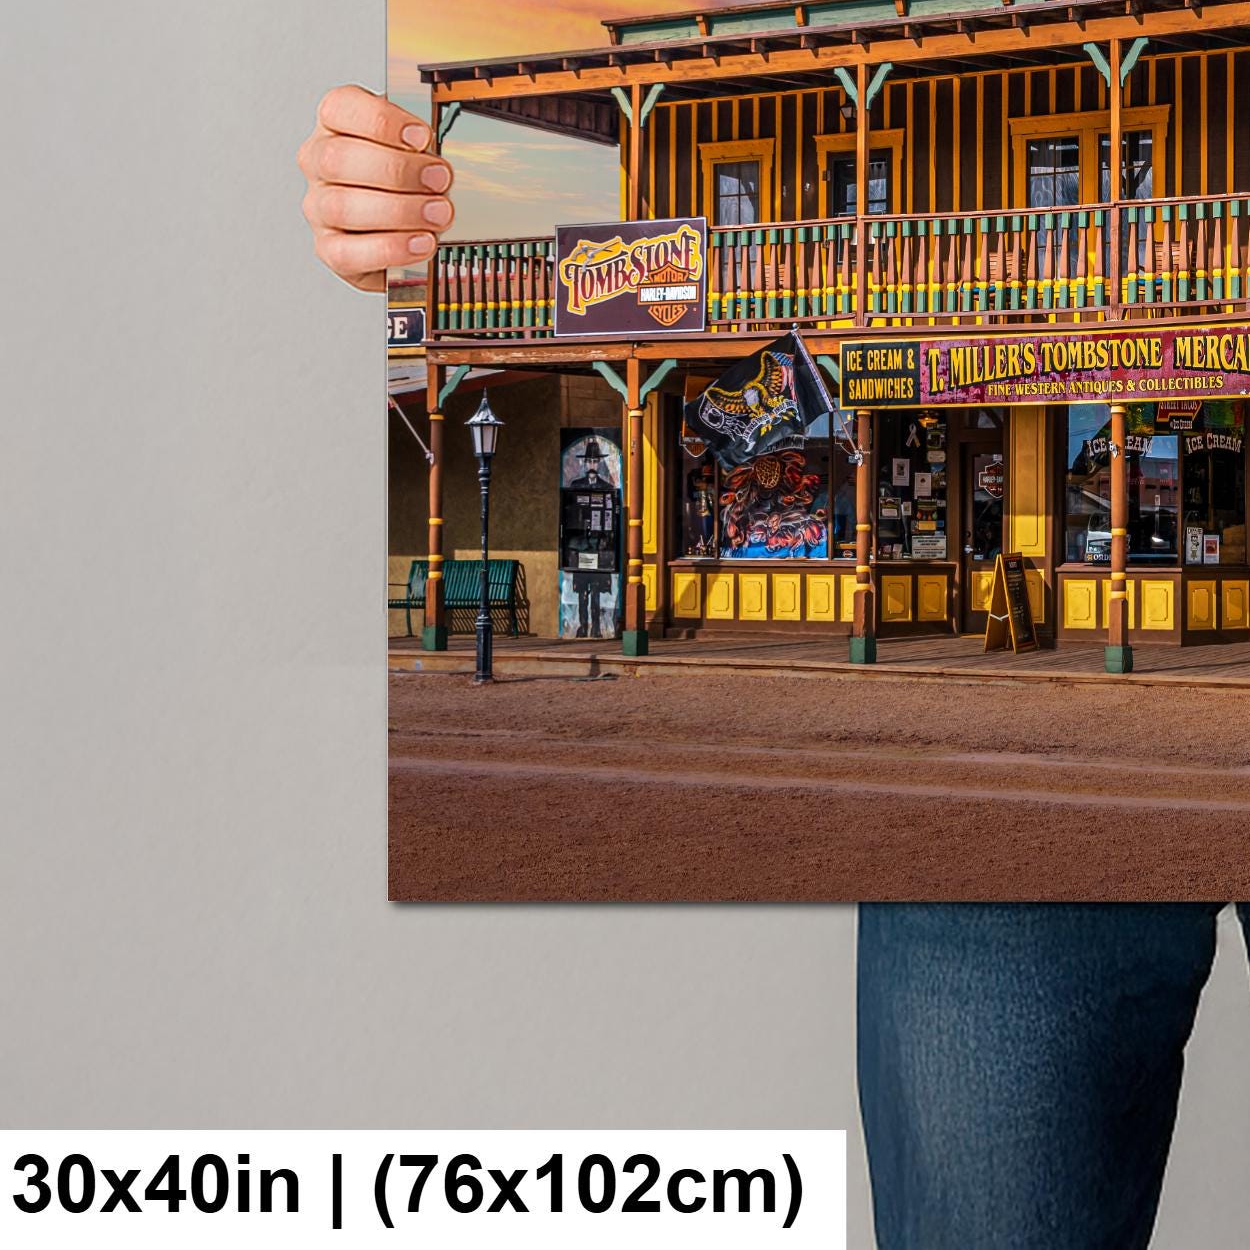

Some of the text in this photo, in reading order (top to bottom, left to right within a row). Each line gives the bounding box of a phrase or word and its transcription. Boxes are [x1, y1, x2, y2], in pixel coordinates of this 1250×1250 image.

[653, 268, 684, 283] MOTOR
[640, 286, 697, 302] HARLEY-DAVIDSON
[652, 305, 683, 322] CYCLES
[847, 348, 915, 372] ICE CREAM &
[928, 348, 945, 393] T.
[951, 343, 1036, 388] MILLER'S
[1041, 337, 1163, 373] TOMBSTONE
[849, 376, 914, 400] SANDWICHES
[988, 375, 1223, 396] FINE WESTERN ANTIQUES & COLLECTIBLES
[1160, 401, 1198, 410] STREET TACOS
[1087, 437, 1107, 457] ICE
[1186, 433, 1243, 454] ICE CREAM
